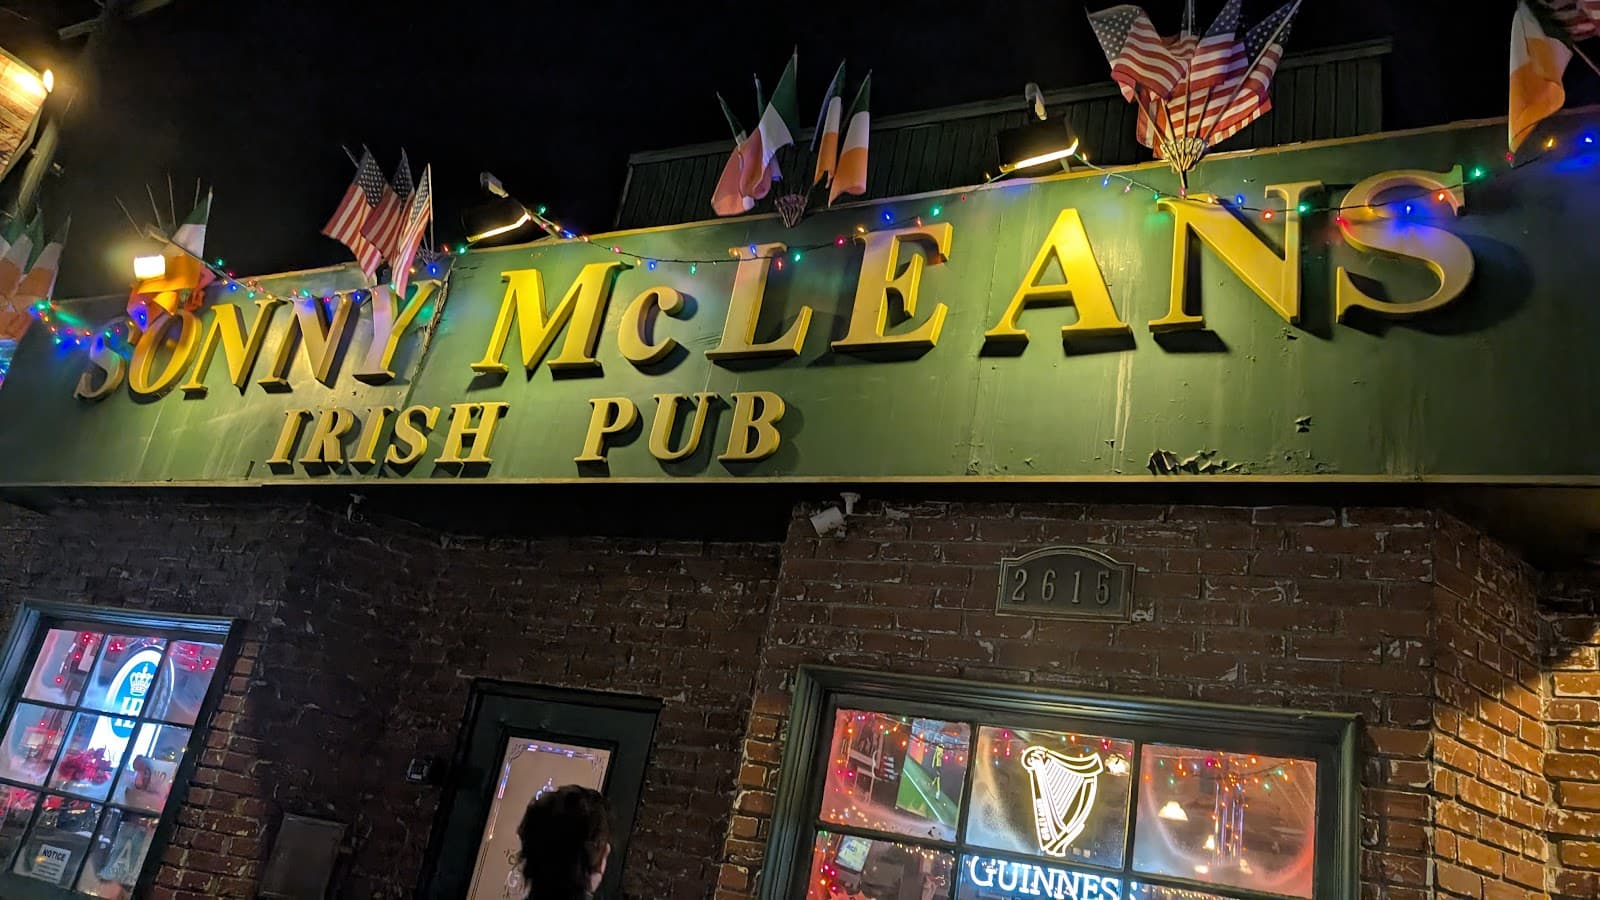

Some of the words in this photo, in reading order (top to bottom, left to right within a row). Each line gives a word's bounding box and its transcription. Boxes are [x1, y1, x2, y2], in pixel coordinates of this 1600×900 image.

[74, 279, 442, 399] SONNY
[266, 402, 509, 466] IRISH
[575, 391, 786, 466] PUB
[1012, 568, 1110, 604] 2615
[42, 848, 66, 862] NOTICE
